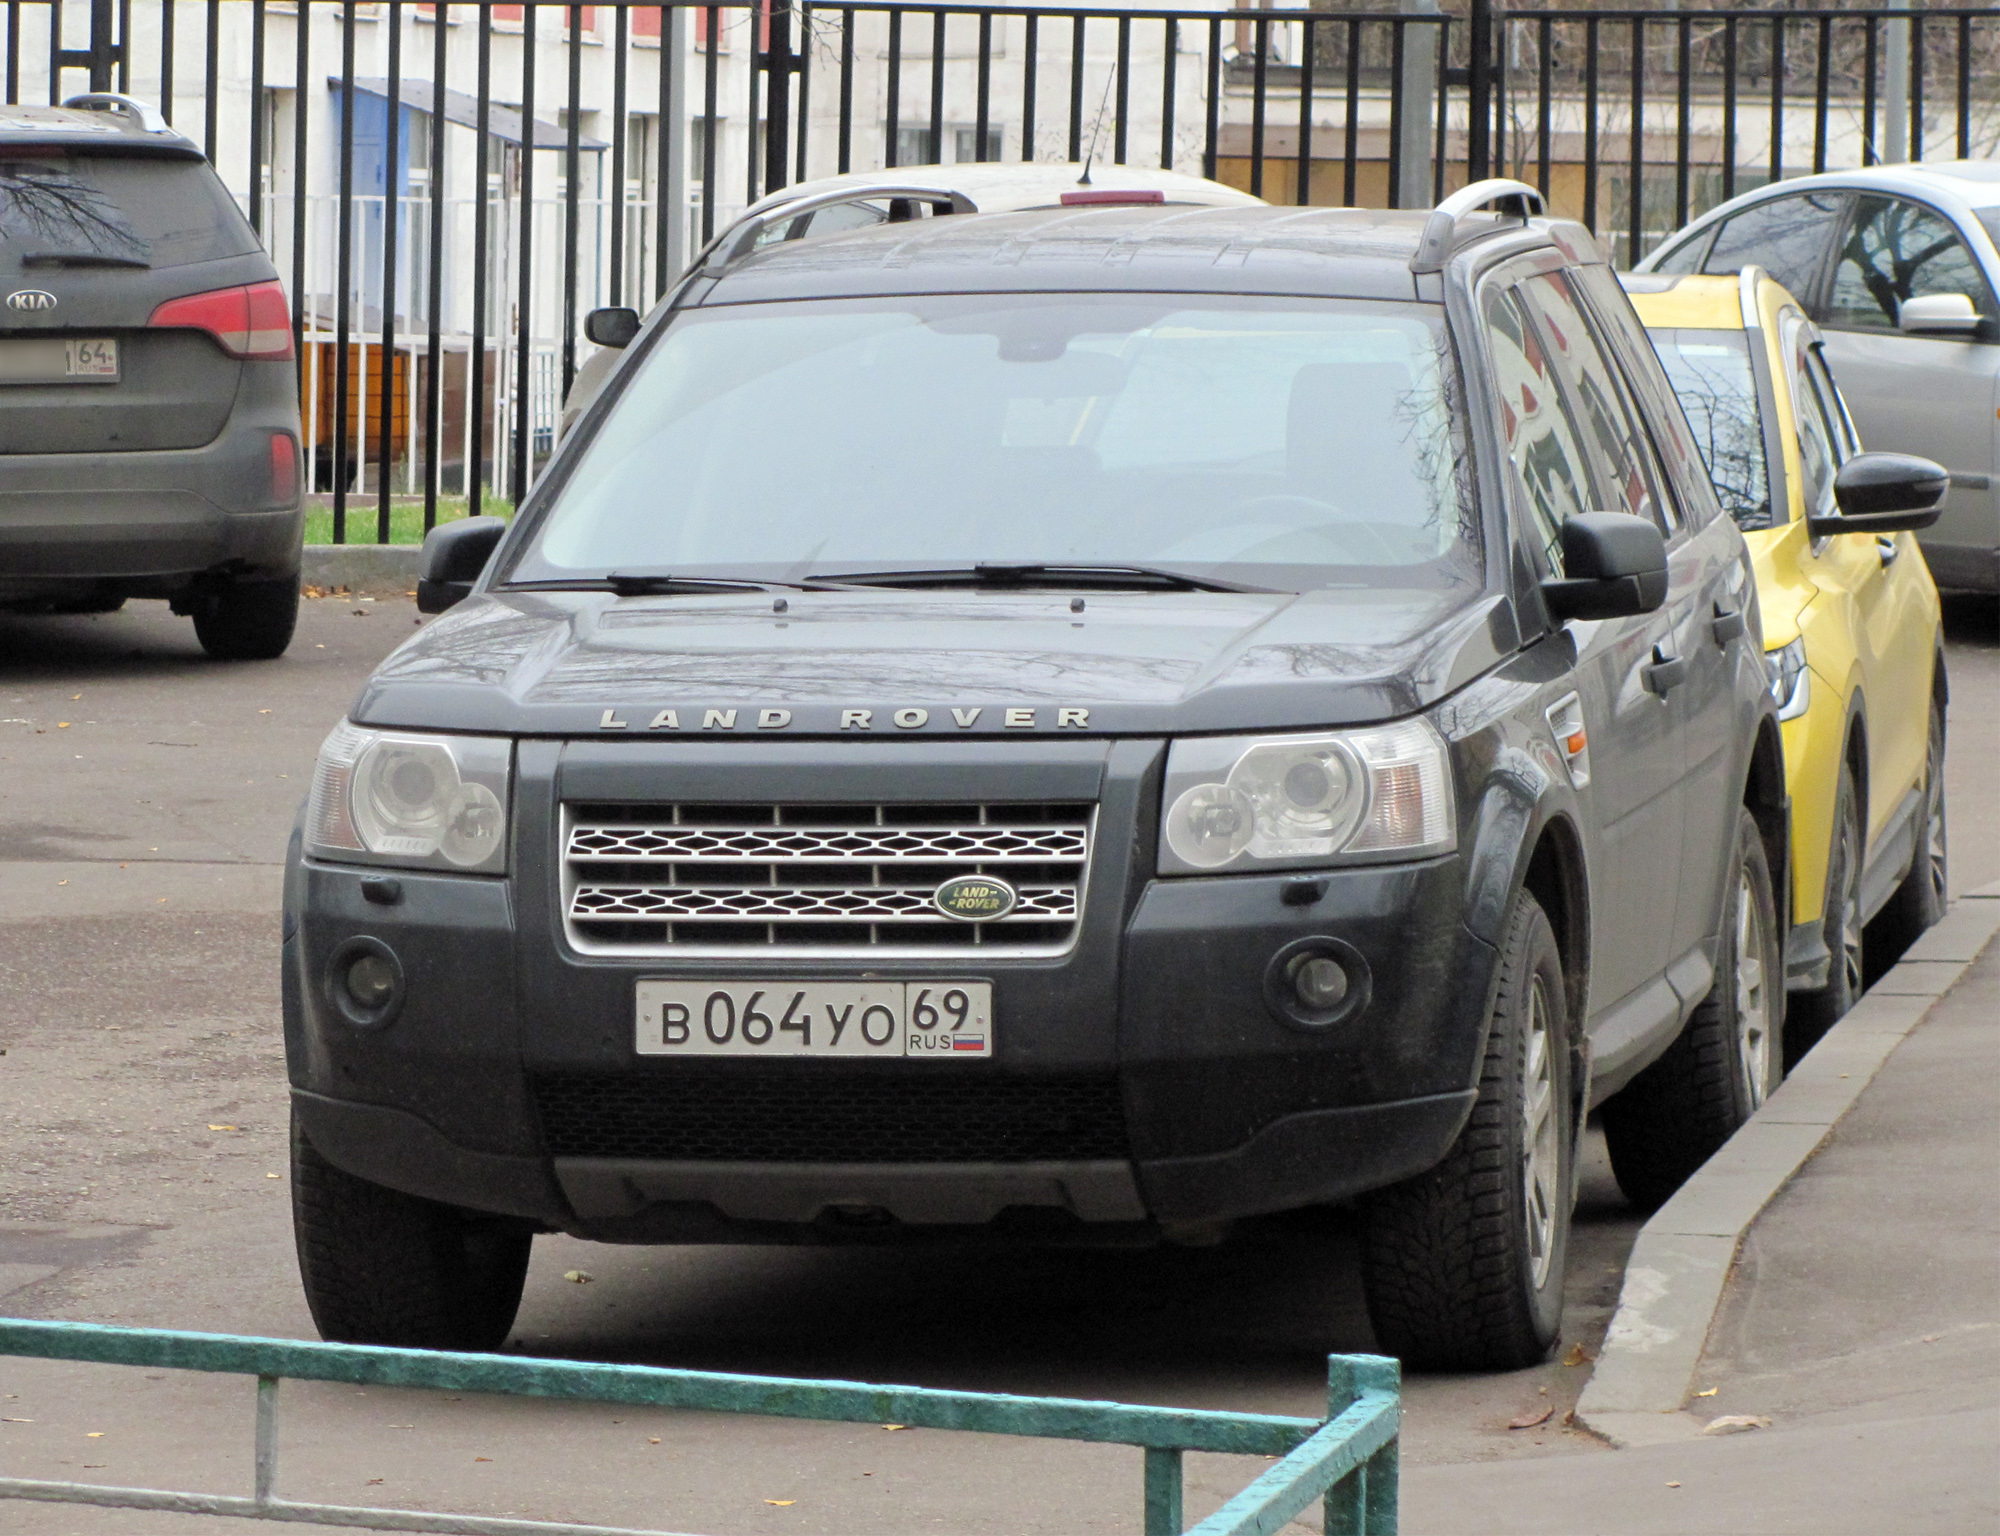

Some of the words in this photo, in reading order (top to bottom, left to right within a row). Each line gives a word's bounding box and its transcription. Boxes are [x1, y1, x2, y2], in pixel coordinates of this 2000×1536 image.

[14, 294, 49, 309] KIA
[79, 342, 107, 364] 64
[599, 709, 793, 730] LAND
[840, 708, 1090, 730] ROVER
[912, 989, 969, 1031] 69
[910, 1034, 951, 1050] RUS
